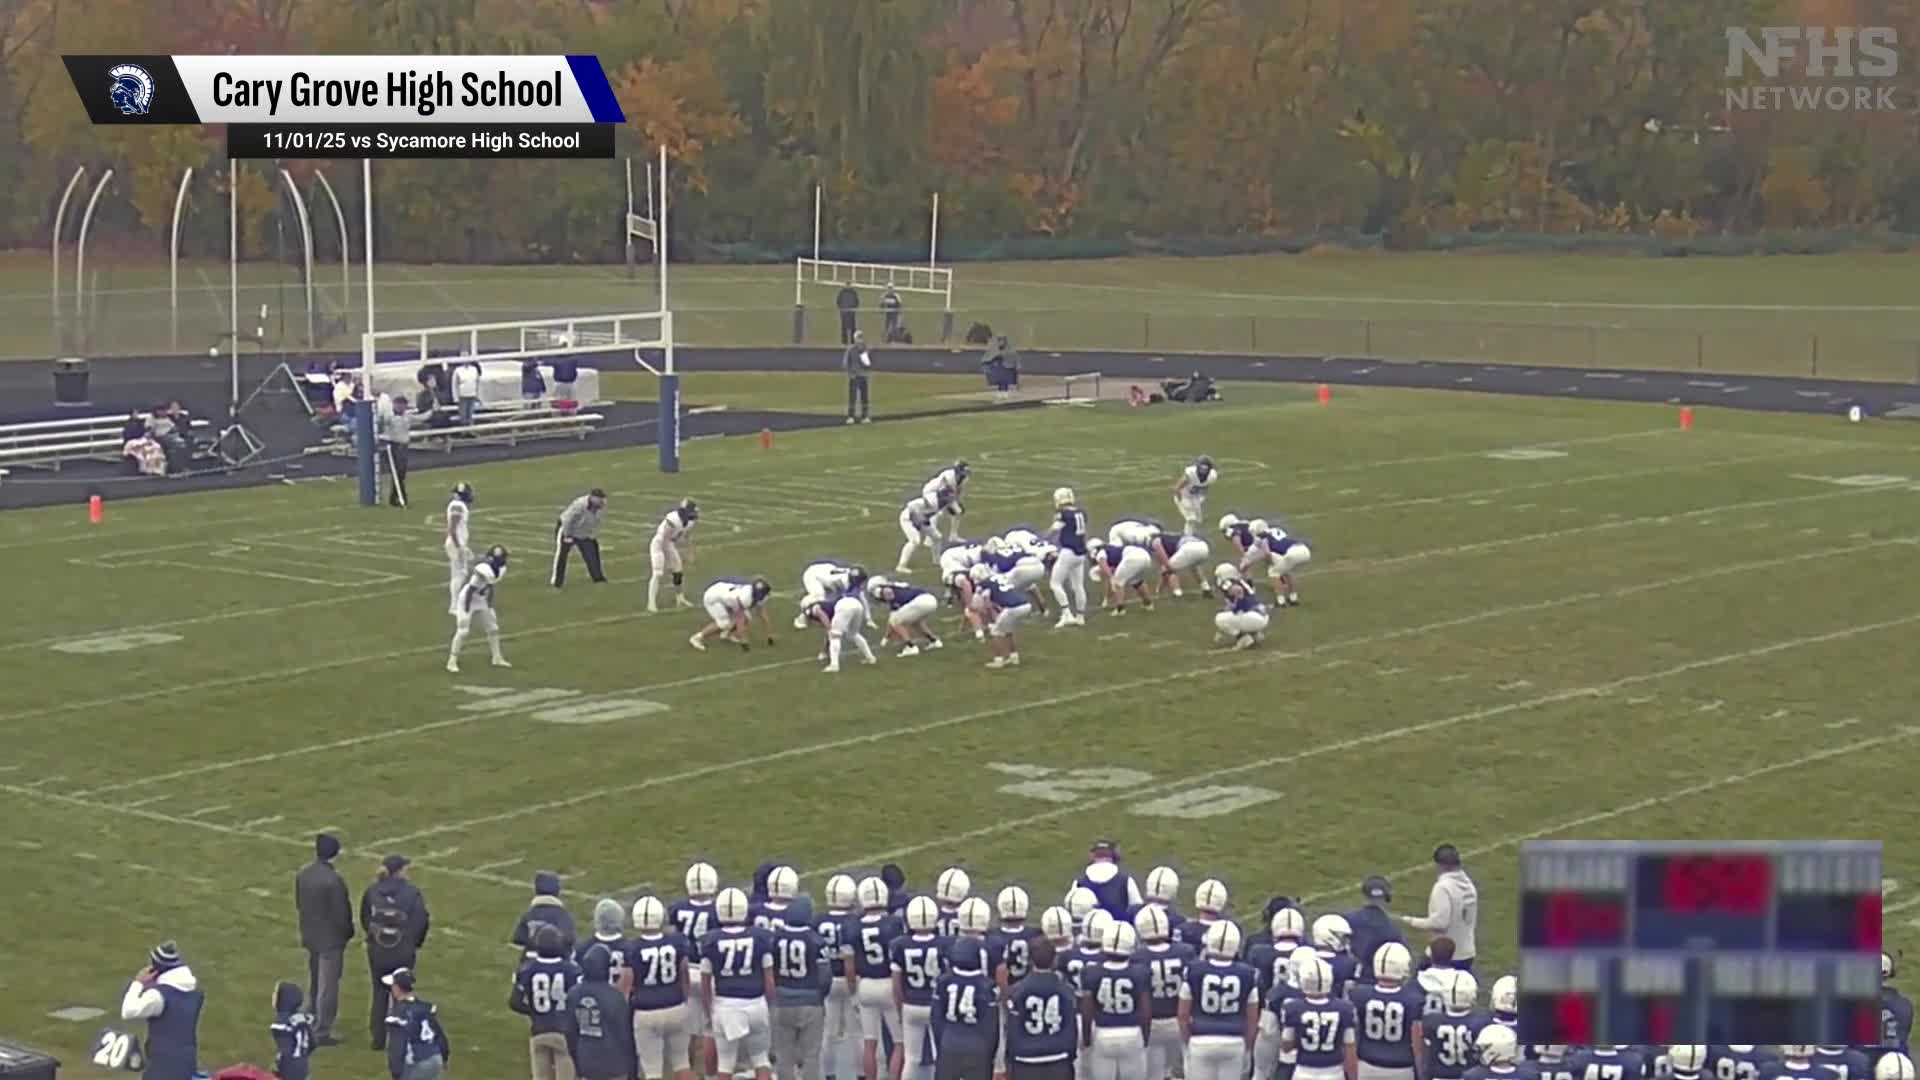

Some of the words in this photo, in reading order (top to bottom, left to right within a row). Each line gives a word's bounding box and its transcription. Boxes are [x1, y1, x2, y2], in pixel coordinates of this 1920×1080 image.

[677, 910, 710, 946] 74
[861, 927, 884, 965] 5
[641, 946, 678, 985] 78
[718, 937, 754, 977] 77
[778, 938, 806, 978] 19
[904, 948, 940, 988] 54
[532, 972, 566, 1013] 84
[946, 983, 977, 1024] 14
[1097, 978, 1134, 1015] 46
[1202, 974, 1240, 1014] 62
[420, 1019, 435, 1041] 4
[1025, 995, 1062, 1035] 34
[1301, 1011, 1340, 1051] 37
[1365, 1000, 1404, 1041] 68
[93, 1031, 129, 1068] 20
